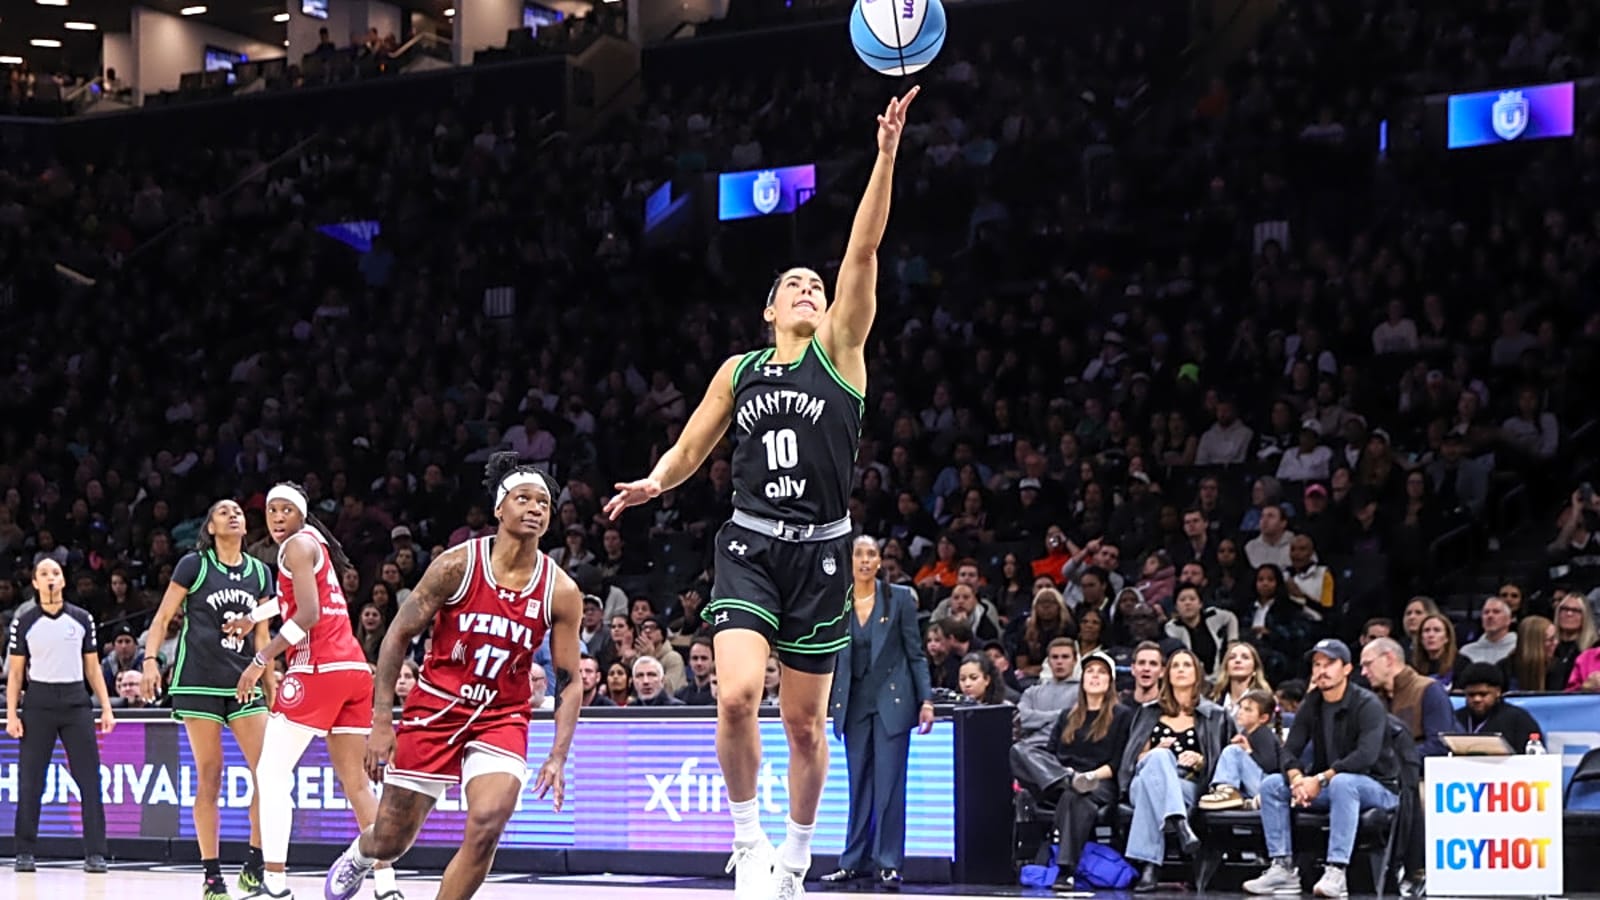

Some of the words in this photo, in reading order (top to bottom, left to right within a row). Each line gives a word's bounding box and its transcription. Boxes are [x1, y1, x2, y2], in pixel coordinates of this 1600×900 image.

[737, 389, 826, 435] PHANTOM
[762, 428, 798, 470] 10
[765, 475, 806, 499] ally
[206, 588, 258, 612] PHANTO
[220, 636, 245, 653] ally
[459, 612, 533, 651] VINYL
[474, 643, 511, 679] 17
[460, 683, 498, 705] ally
